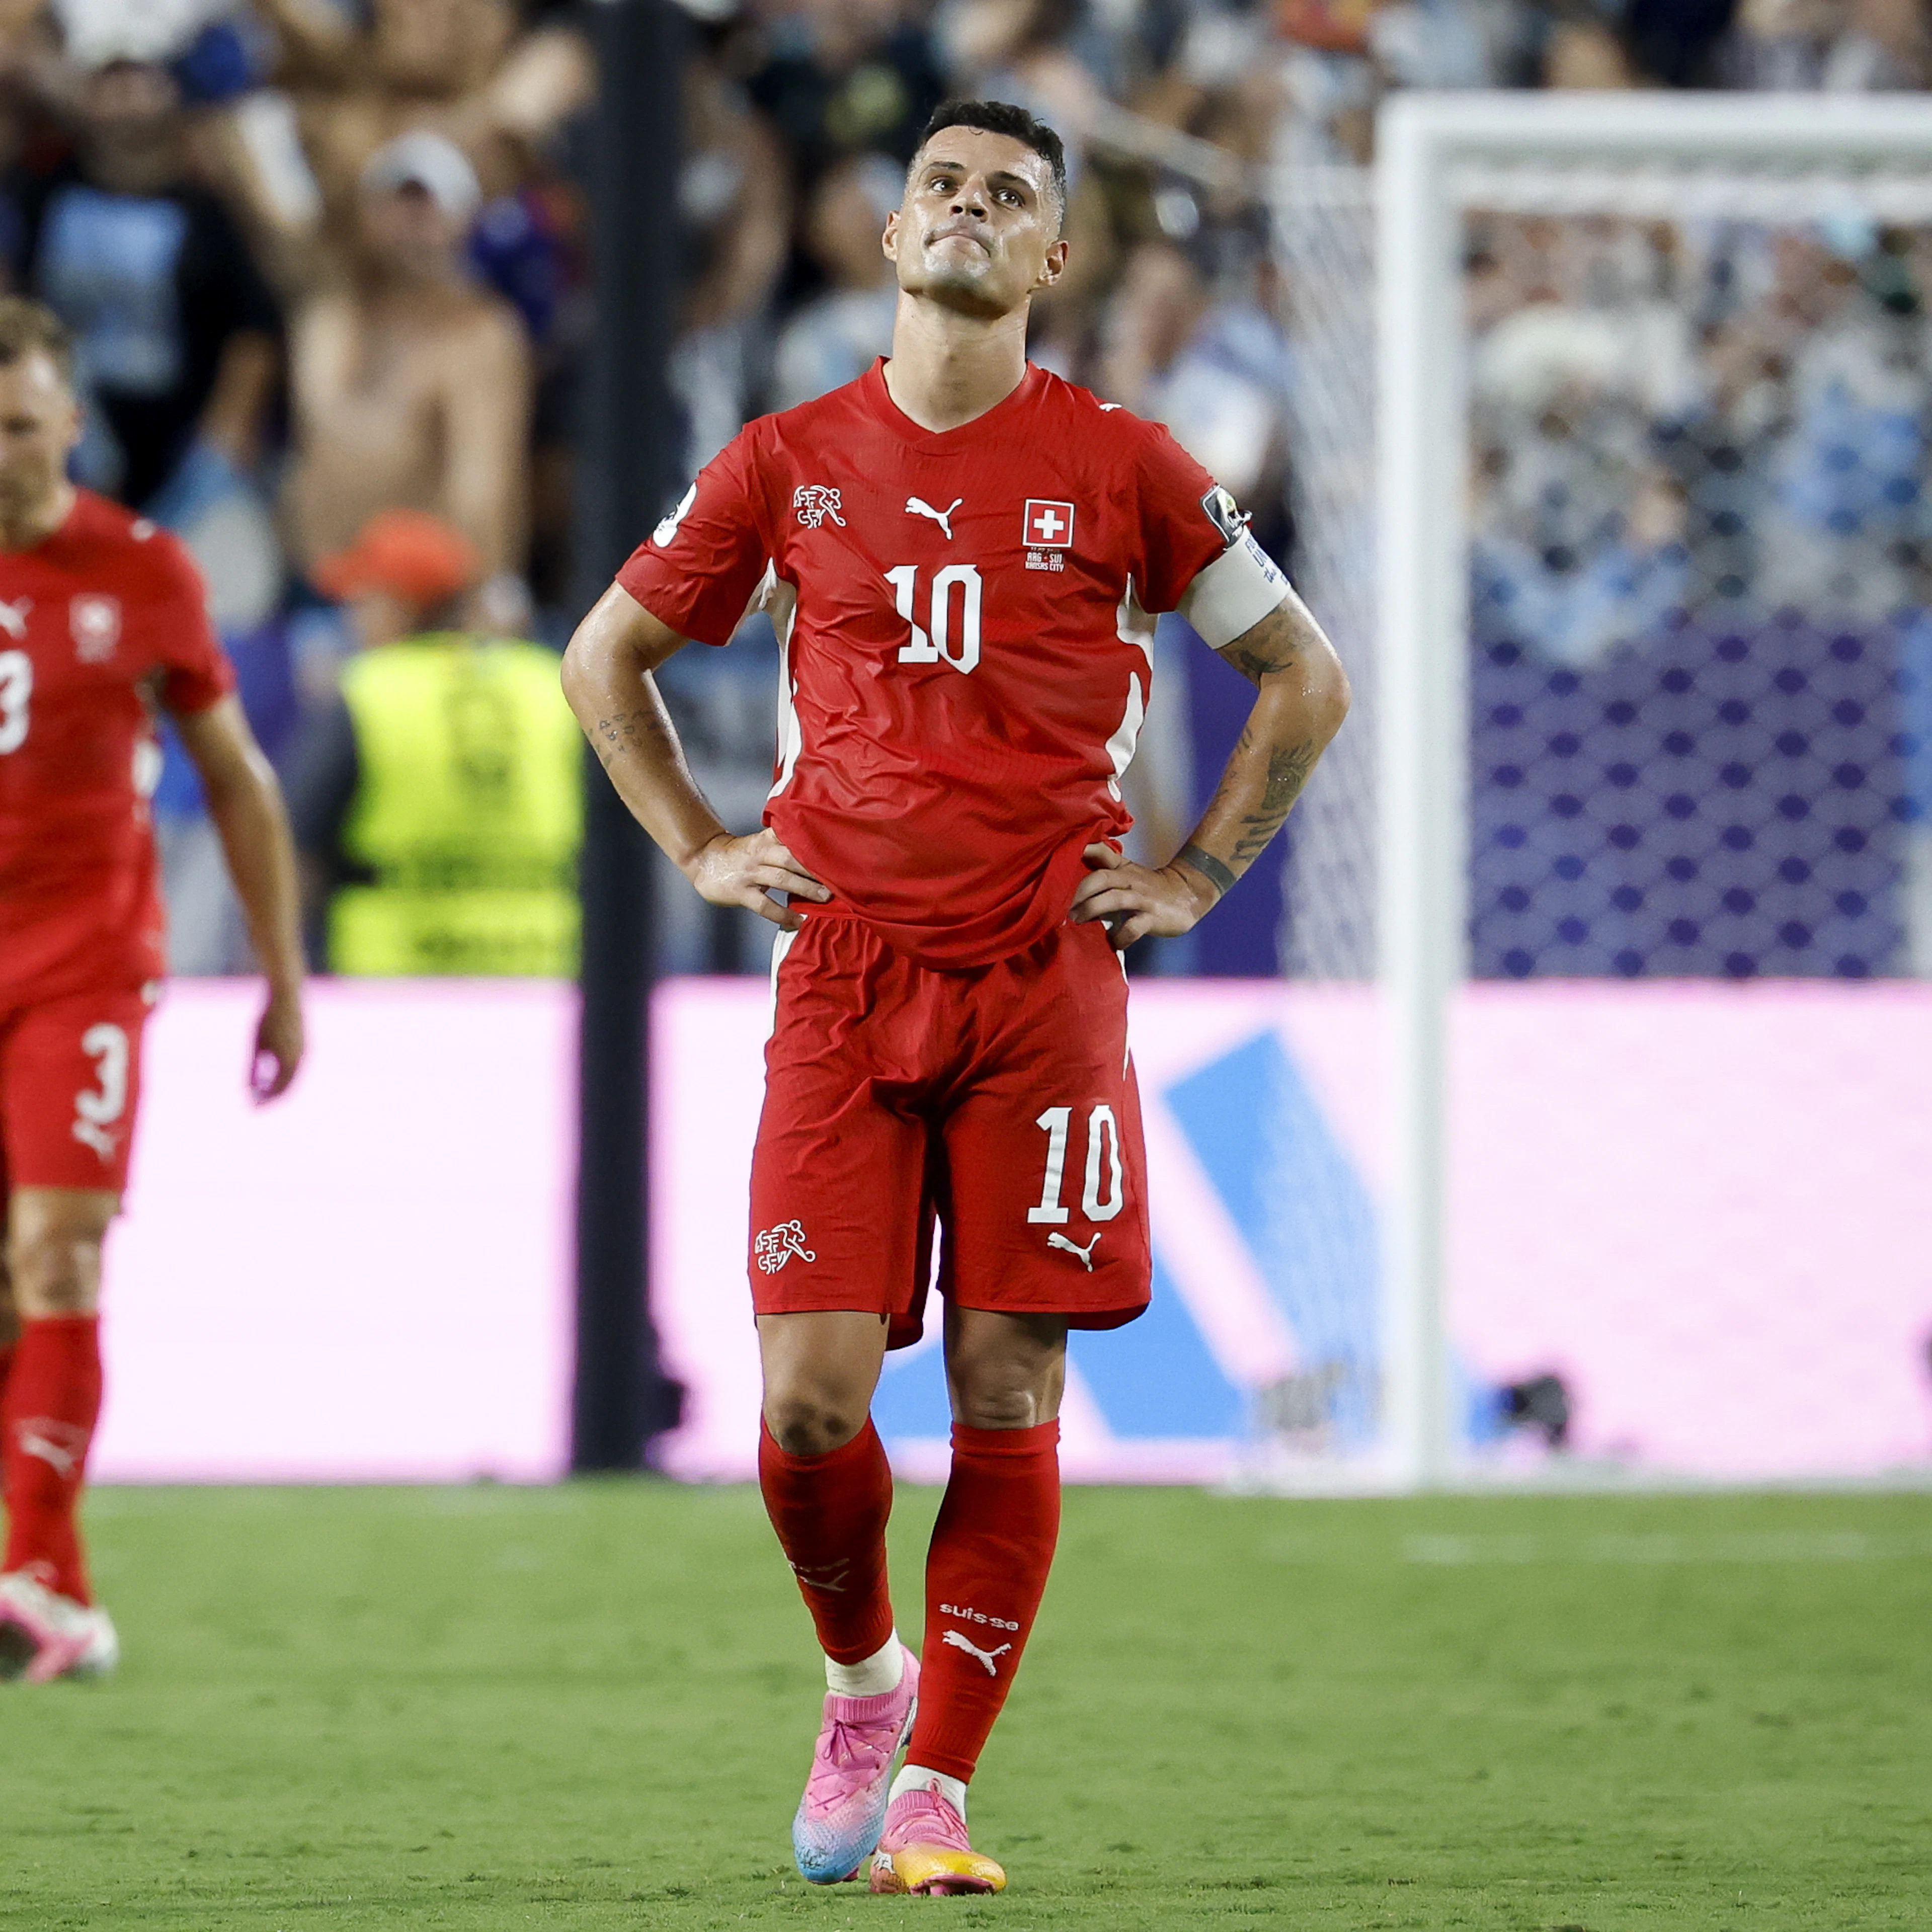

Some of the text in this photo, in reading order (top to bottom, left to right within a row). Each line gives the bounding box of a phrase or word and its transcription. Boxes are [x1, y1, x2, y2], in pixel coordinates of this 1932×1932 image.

[1025, 561, 1064, 572] KANSAS CITY
[1027, 552, 1063, 564] ARG SUI
[883, 564, 982, 675] 10
[75, 1022, 129, 1124] 3
[1027, 1104, 1123, 1224] 10
[939, 1603, 1019, 1632] suisse
